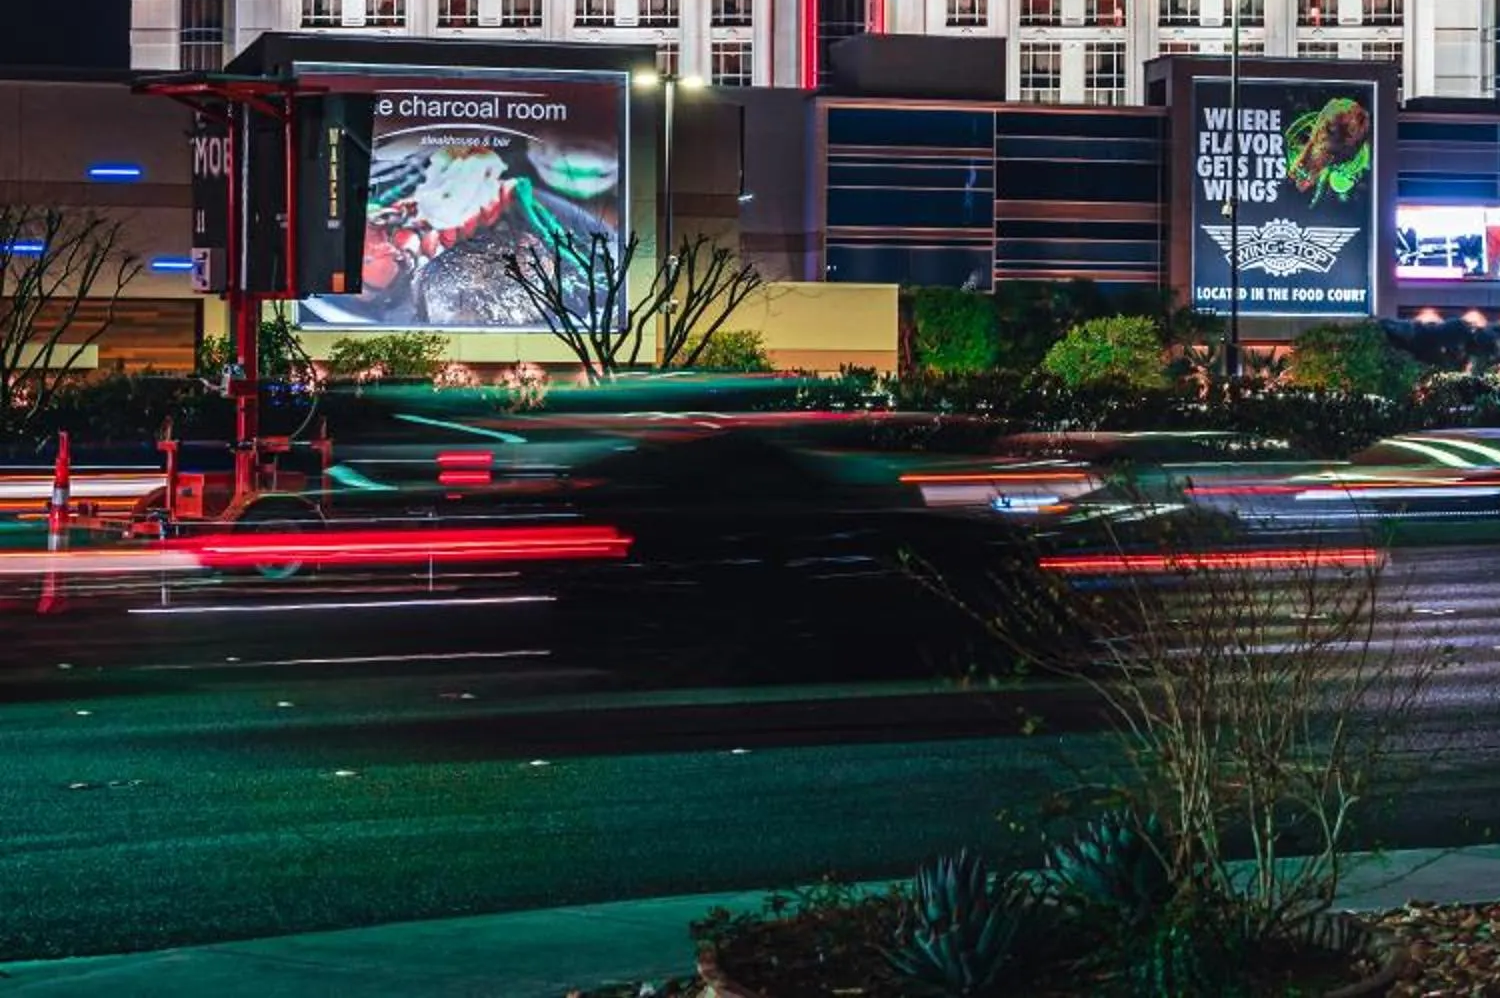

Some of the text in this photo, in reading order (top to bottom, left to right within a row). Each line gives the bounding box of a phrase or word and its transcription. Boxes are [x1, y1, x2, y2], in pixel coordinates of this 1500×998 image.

[399, 95, 499, 119] charcoal
[507, 102, 568, 121] room
[1203, 107, 1282, 132] WHERE
[421, 133, 481, 148] steakhouse
[1199, 131, 1285, 155] FLAVOR
[1197, 155, 1288, 180] GETS ITS
[1197, 286, 1368, 303] LOCATD IN THE FOOD COURT
